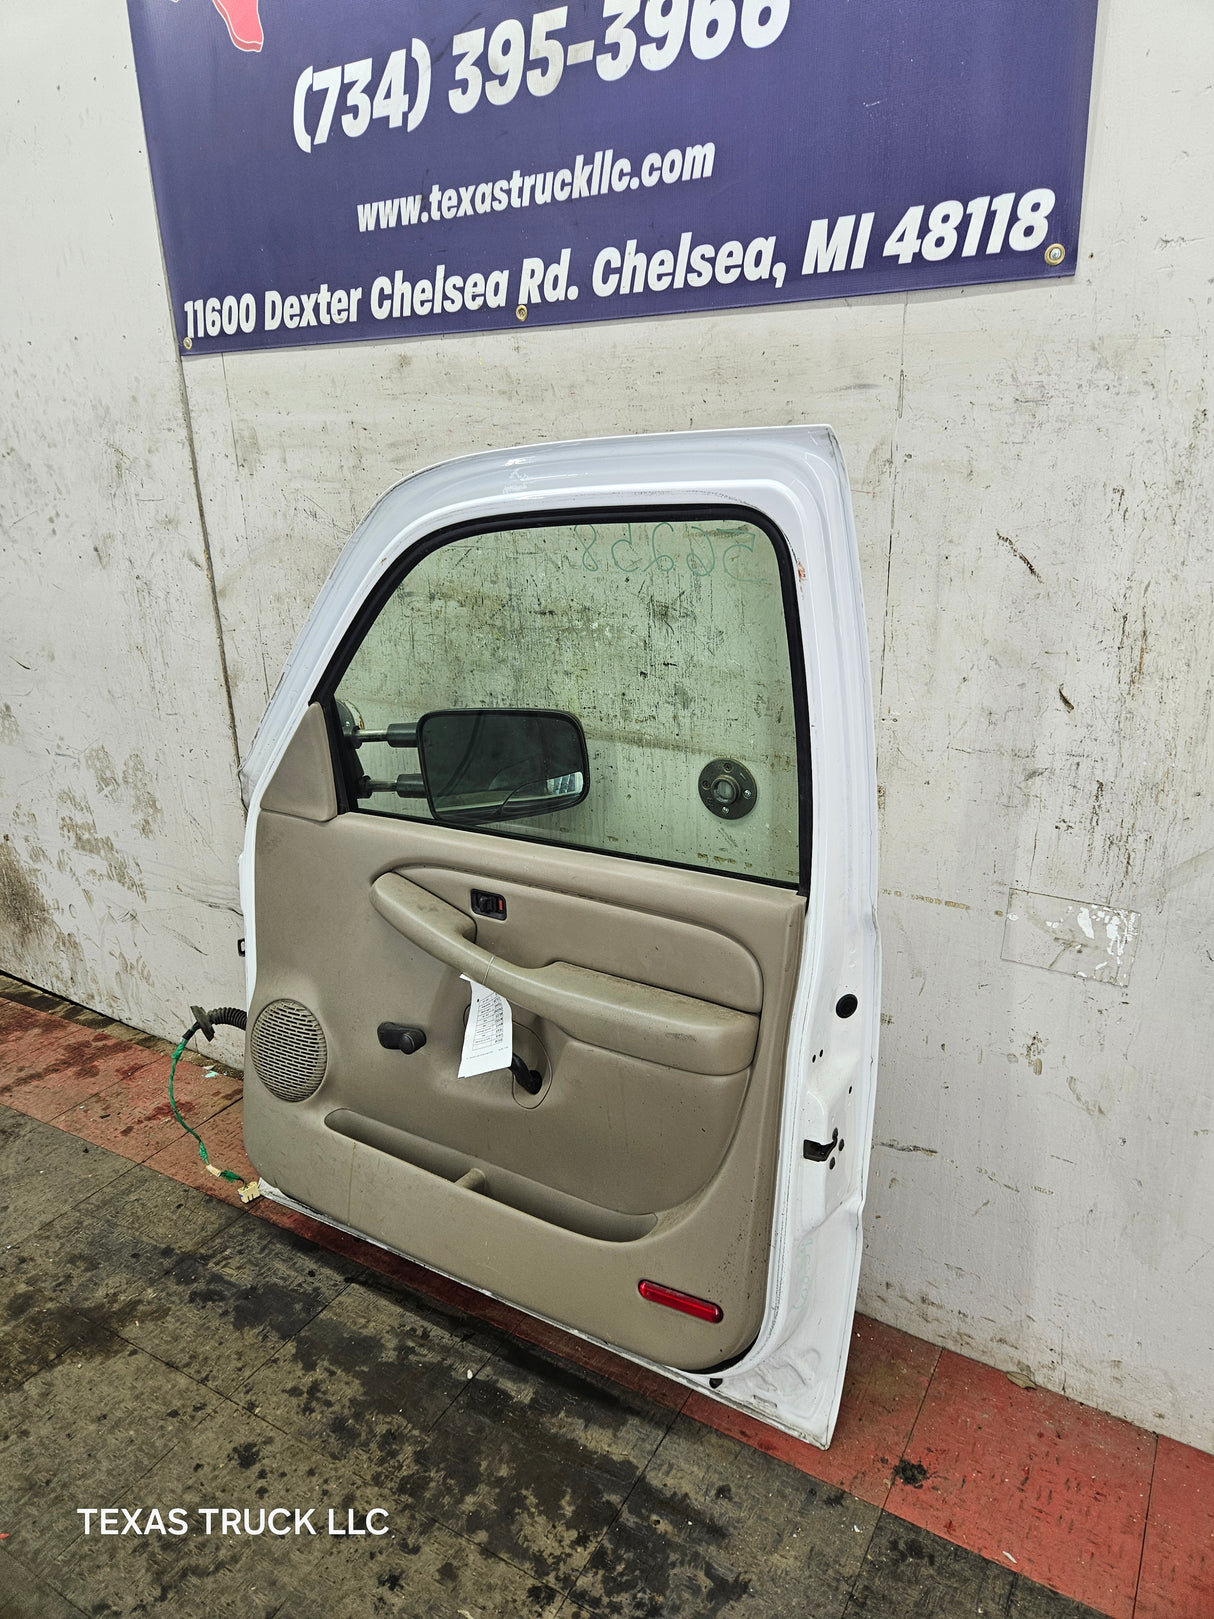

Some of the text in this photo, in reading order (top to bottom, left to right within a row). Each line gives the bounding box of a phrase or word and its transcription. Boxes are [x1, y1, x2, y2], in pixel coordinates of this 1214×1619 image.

[293, 38, 432, 153] (734)
[356, 143, 716, 233] www.texastruckllc.com
[184, 188, 1057, 338] 11600 Dexter Chelsea Rd. Chelsea, MI 48118
